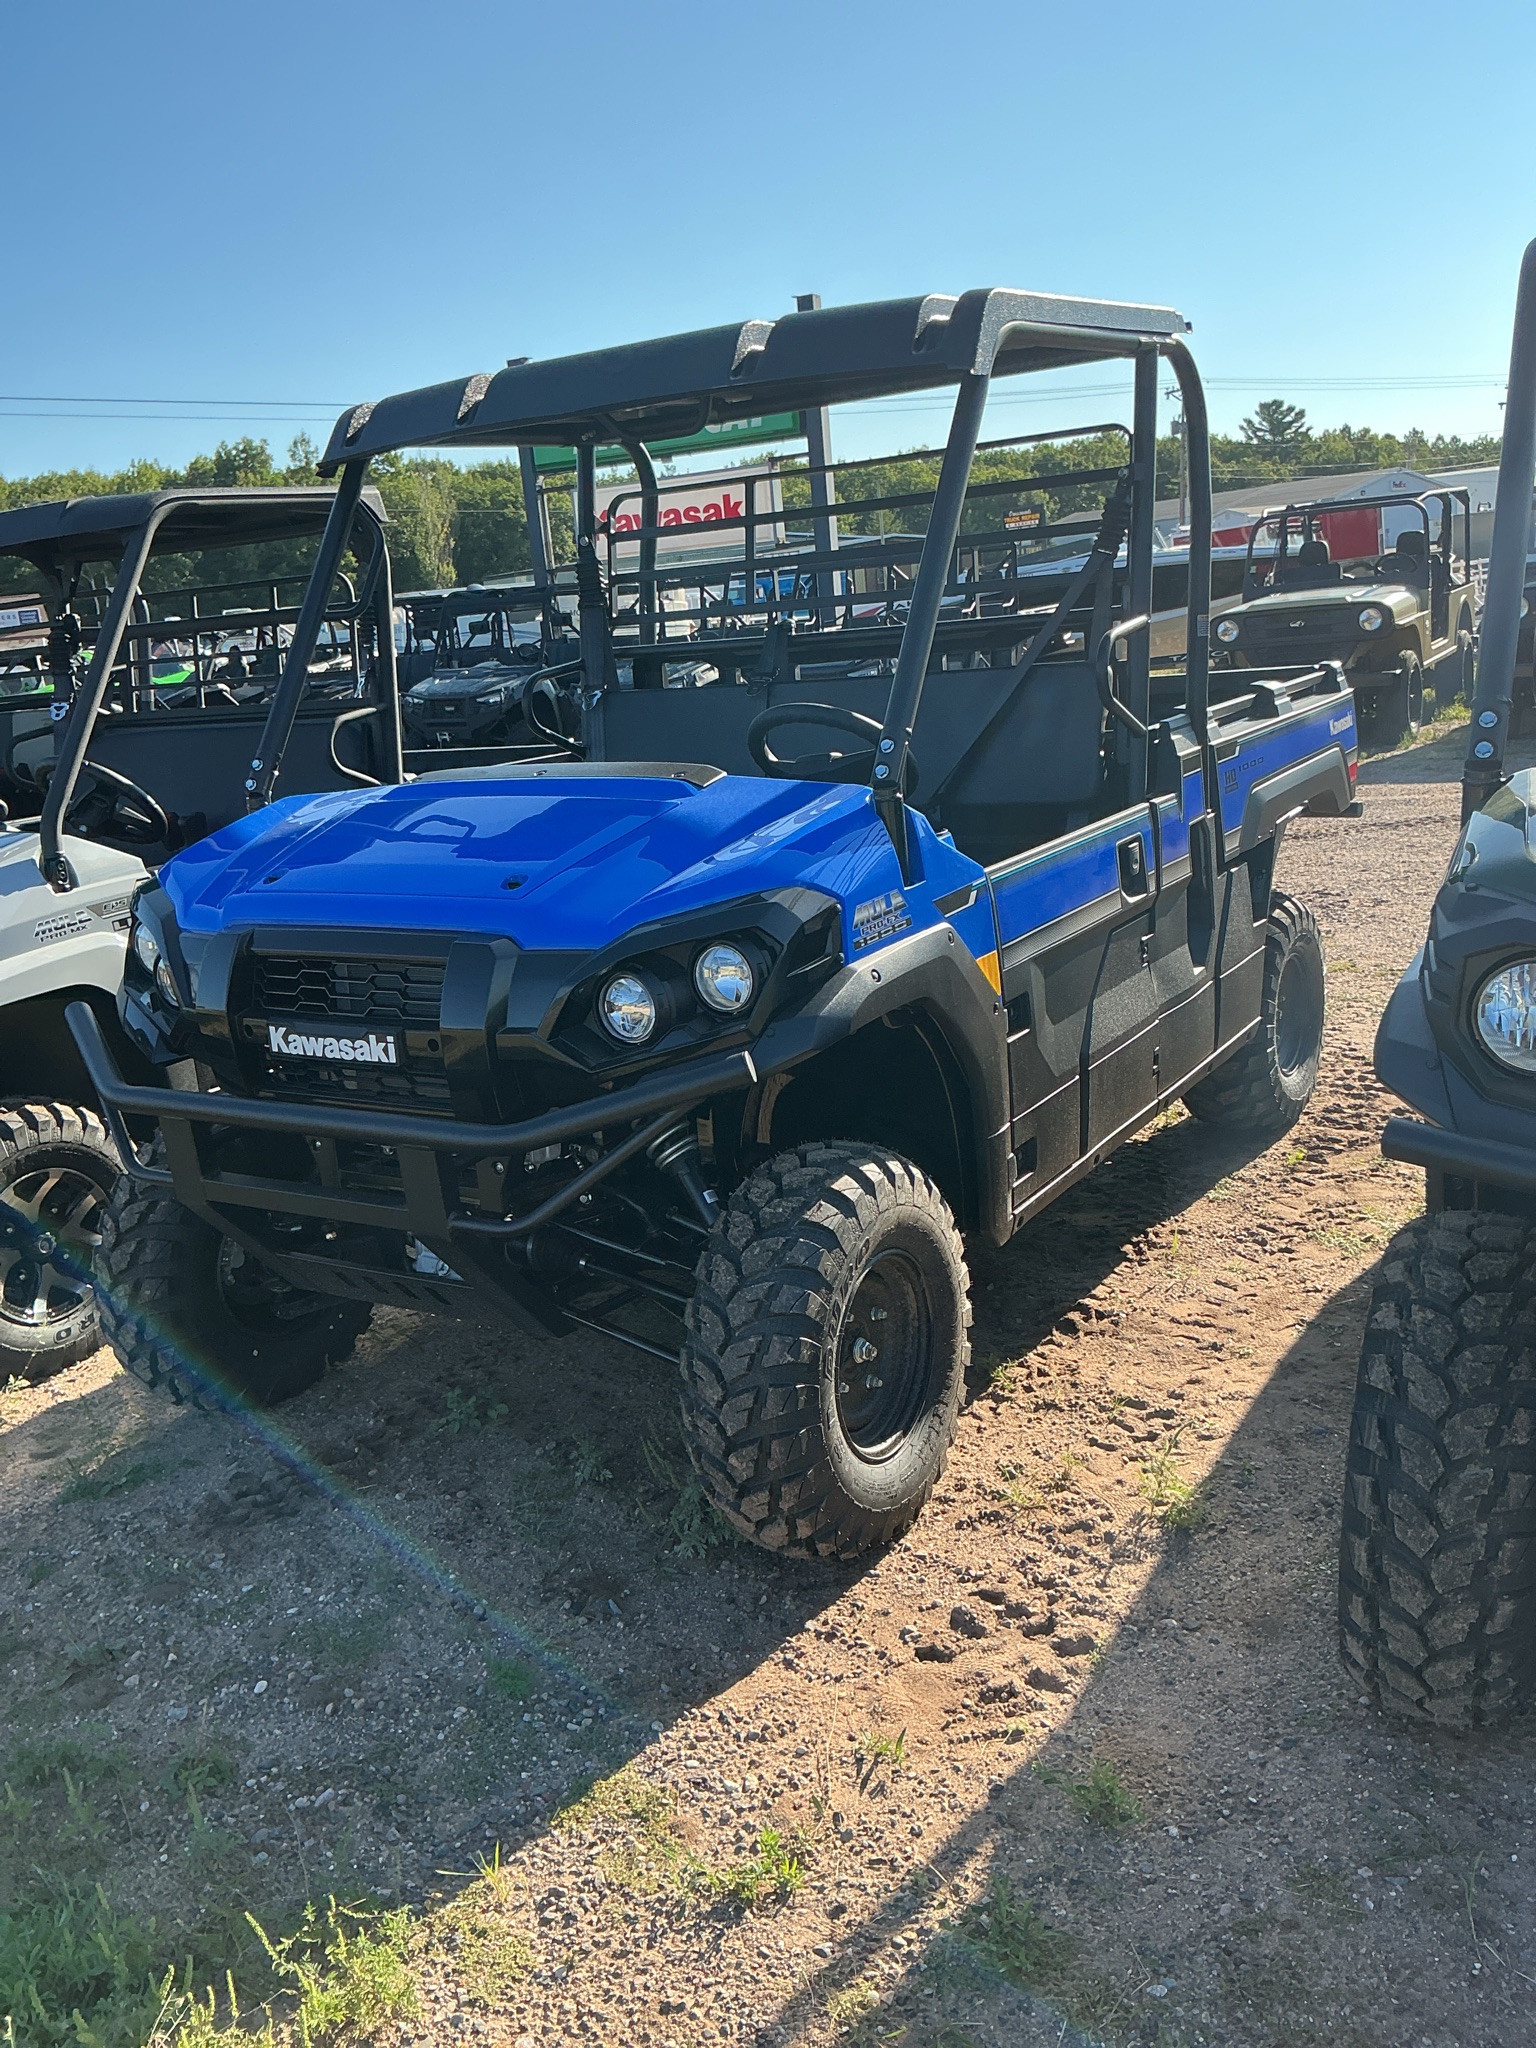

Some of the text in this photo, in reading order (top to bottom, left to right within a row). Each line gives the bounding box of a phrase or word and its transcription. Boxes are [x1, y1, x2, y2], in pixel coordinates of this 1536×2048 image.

[596, 493, 743, 541] aasak
[1238, 757, 1264, 772] 1000
[33, 910, 93, 938] MULE
[113, 918, 132, 931] L
[853, 889, 908, 930] MULE
[268, 1025, 397, 1063] Kawasaki
